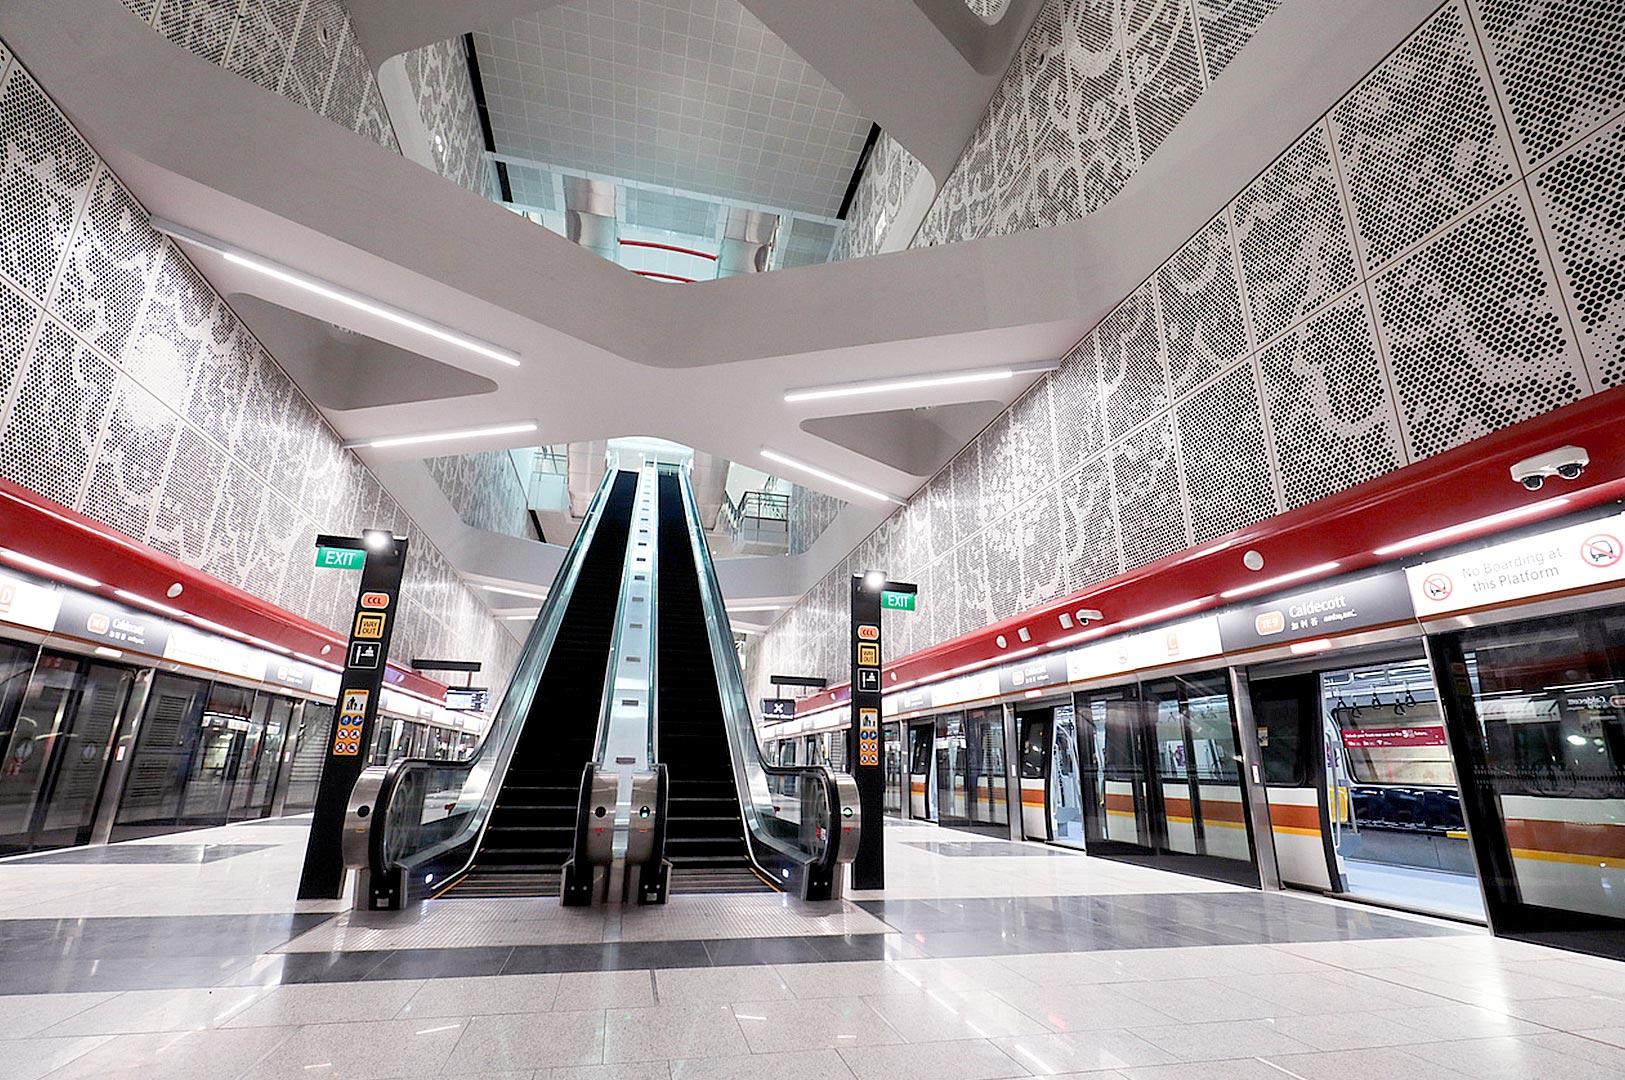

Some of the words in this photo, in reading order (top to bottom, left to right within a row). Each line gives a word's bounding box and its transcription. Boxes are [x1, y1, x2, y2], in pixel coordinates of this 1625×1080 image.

[324, 551, 356, 566] EXIT
[1462, 568, 1480, 578] No
[1483, 553, 1545, 575] Boarding
[1549, 548, 1562, 560] at
[1473, 579, 1497, 592] this
[1499, 566, 1560, 587] Platform
[887, 594, 909, 608] EXIT
[1288, 595, 1347, 618] Caldecott
[362, 627, 376, 635] OUT
[363, 620, 378, 628] WAY
